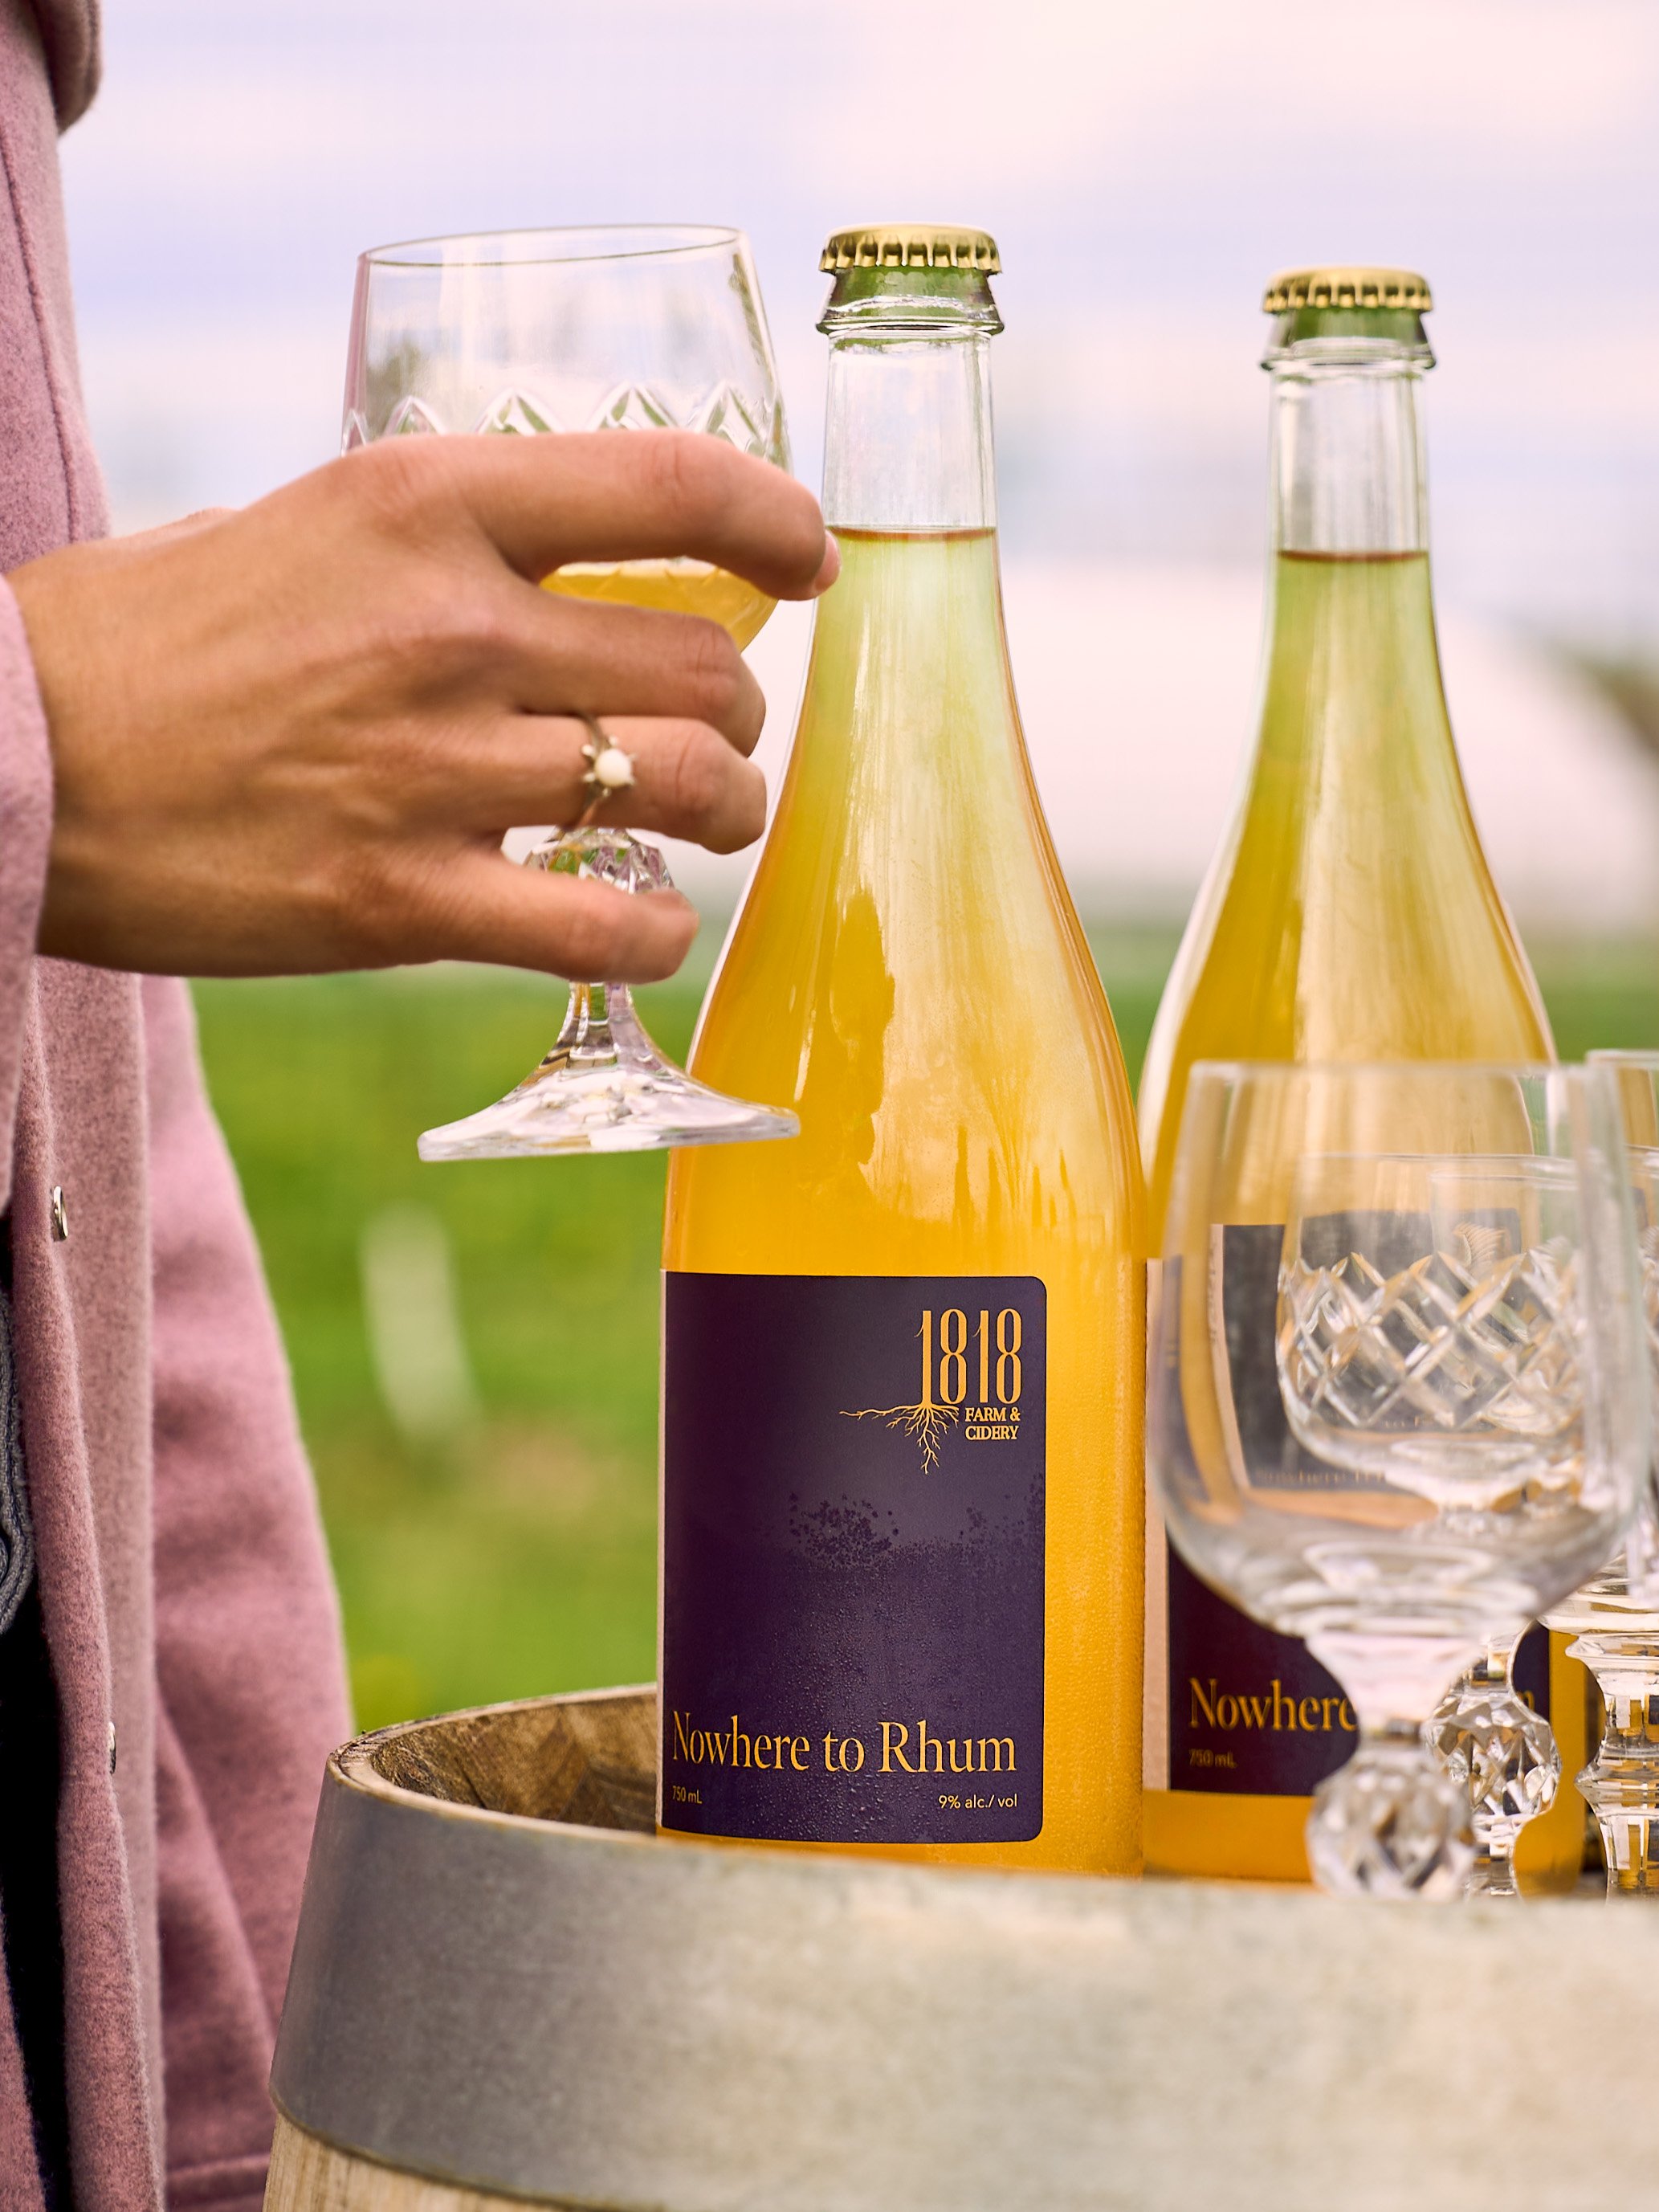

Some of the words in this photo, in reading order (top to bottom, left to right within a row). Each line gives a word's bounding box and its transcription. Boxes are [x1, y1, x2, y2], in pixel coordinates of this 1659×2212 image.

[914, 1308, 1021, 1404] 1818
[964, 1407, 1006, 1422] FARM
[1009, 1406, 1021, 1422] &
[965, 1426, 1019, 1440] CIDERY
[672, 1710, 810, 1770] Nowhere
[822, 1730, 865, 1772] to
[878, 1719, 1017, 1773] Rhum
[1189, 1748, 1213, 1767] 750
[672, 1785, 687, 1802] 750
[687, 1790, 703, 1804] mL
[938, 1794, 961, 1809] 9%
[997, 1793, 1018, 1808] vol
